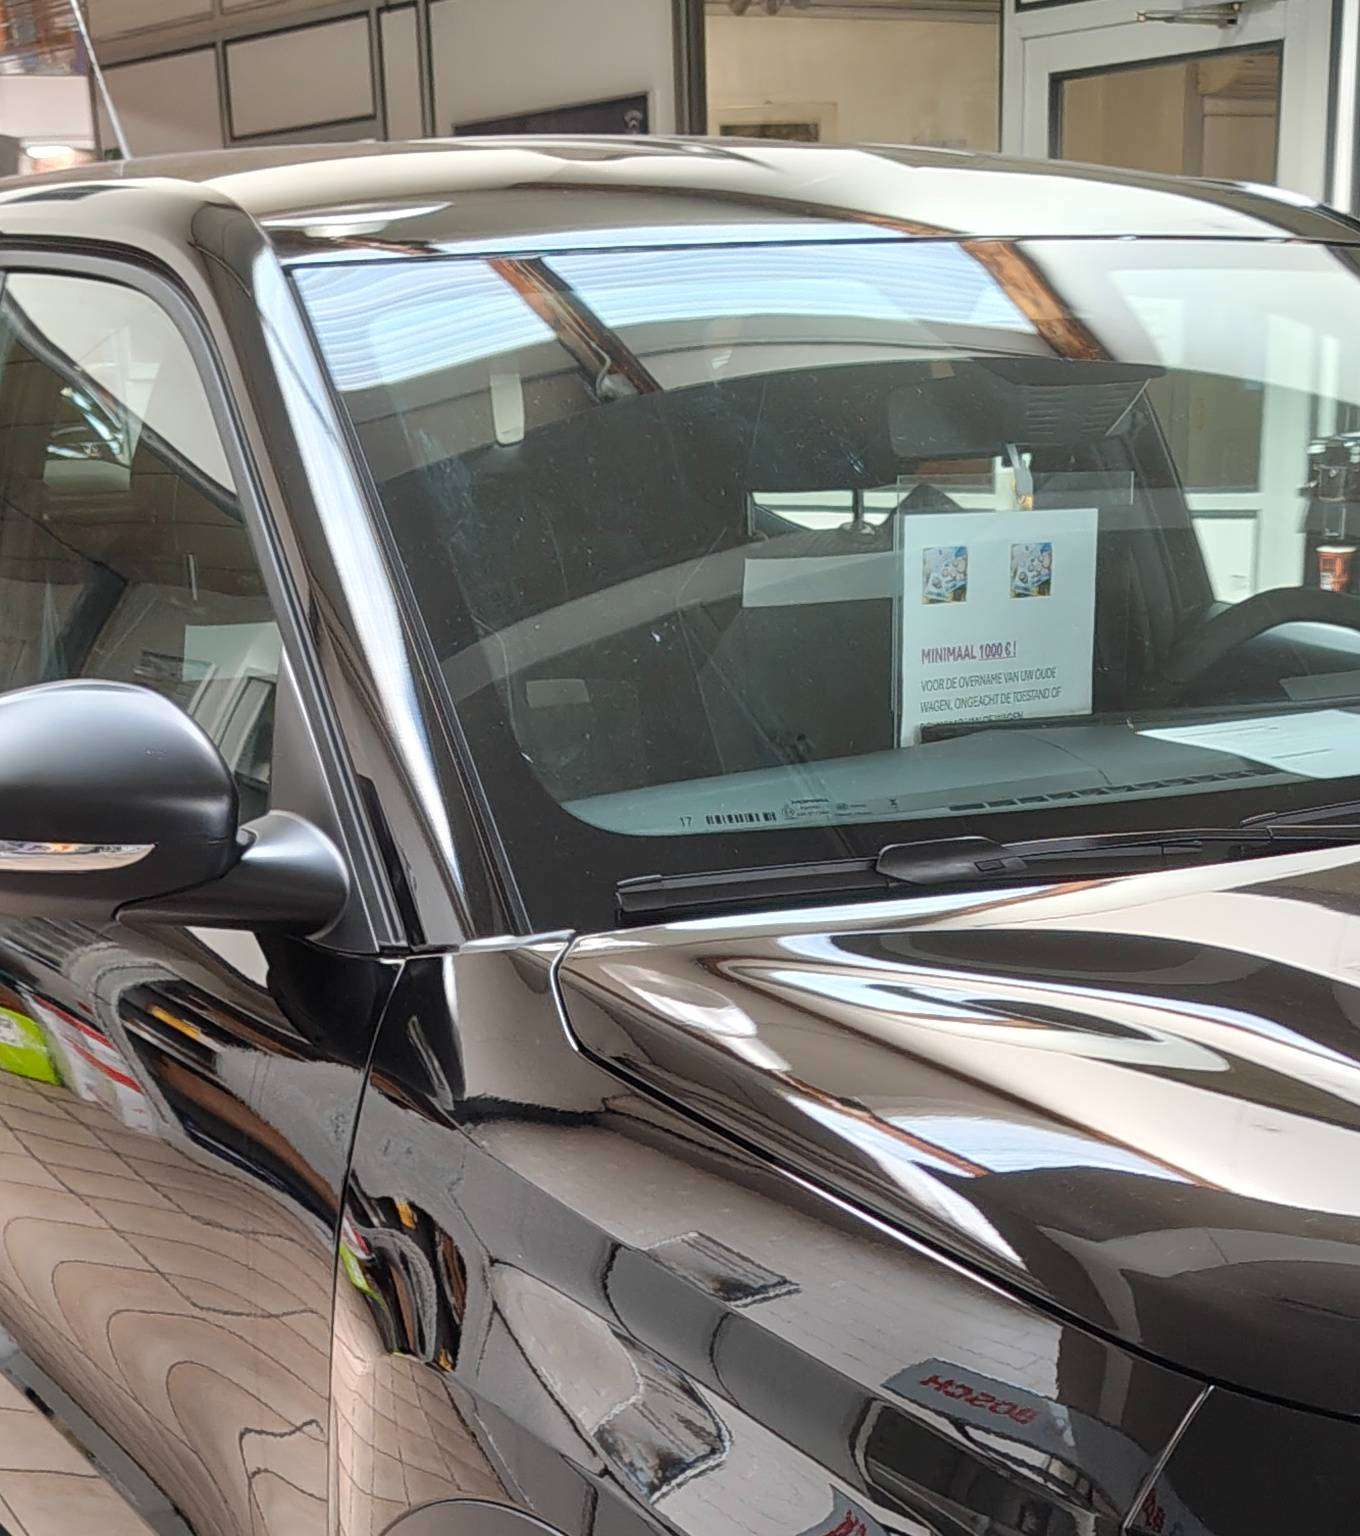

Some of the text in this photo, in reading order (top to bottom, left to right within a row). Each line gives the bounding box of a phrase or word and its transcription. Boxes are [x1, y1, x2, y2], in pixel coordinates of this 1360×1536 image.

[921, 645, 977, 664] MINIMAAL
[978, 642, 1003, 661] 1000
[920, 678, 945, 692] VOOR
[945, 677, 958, 689] DE
[959, 672, 1002, 689] OVERNAME
[1003, 671, 1019, 683] VAN
[954, 693, 999, 709] ONGEACHT
